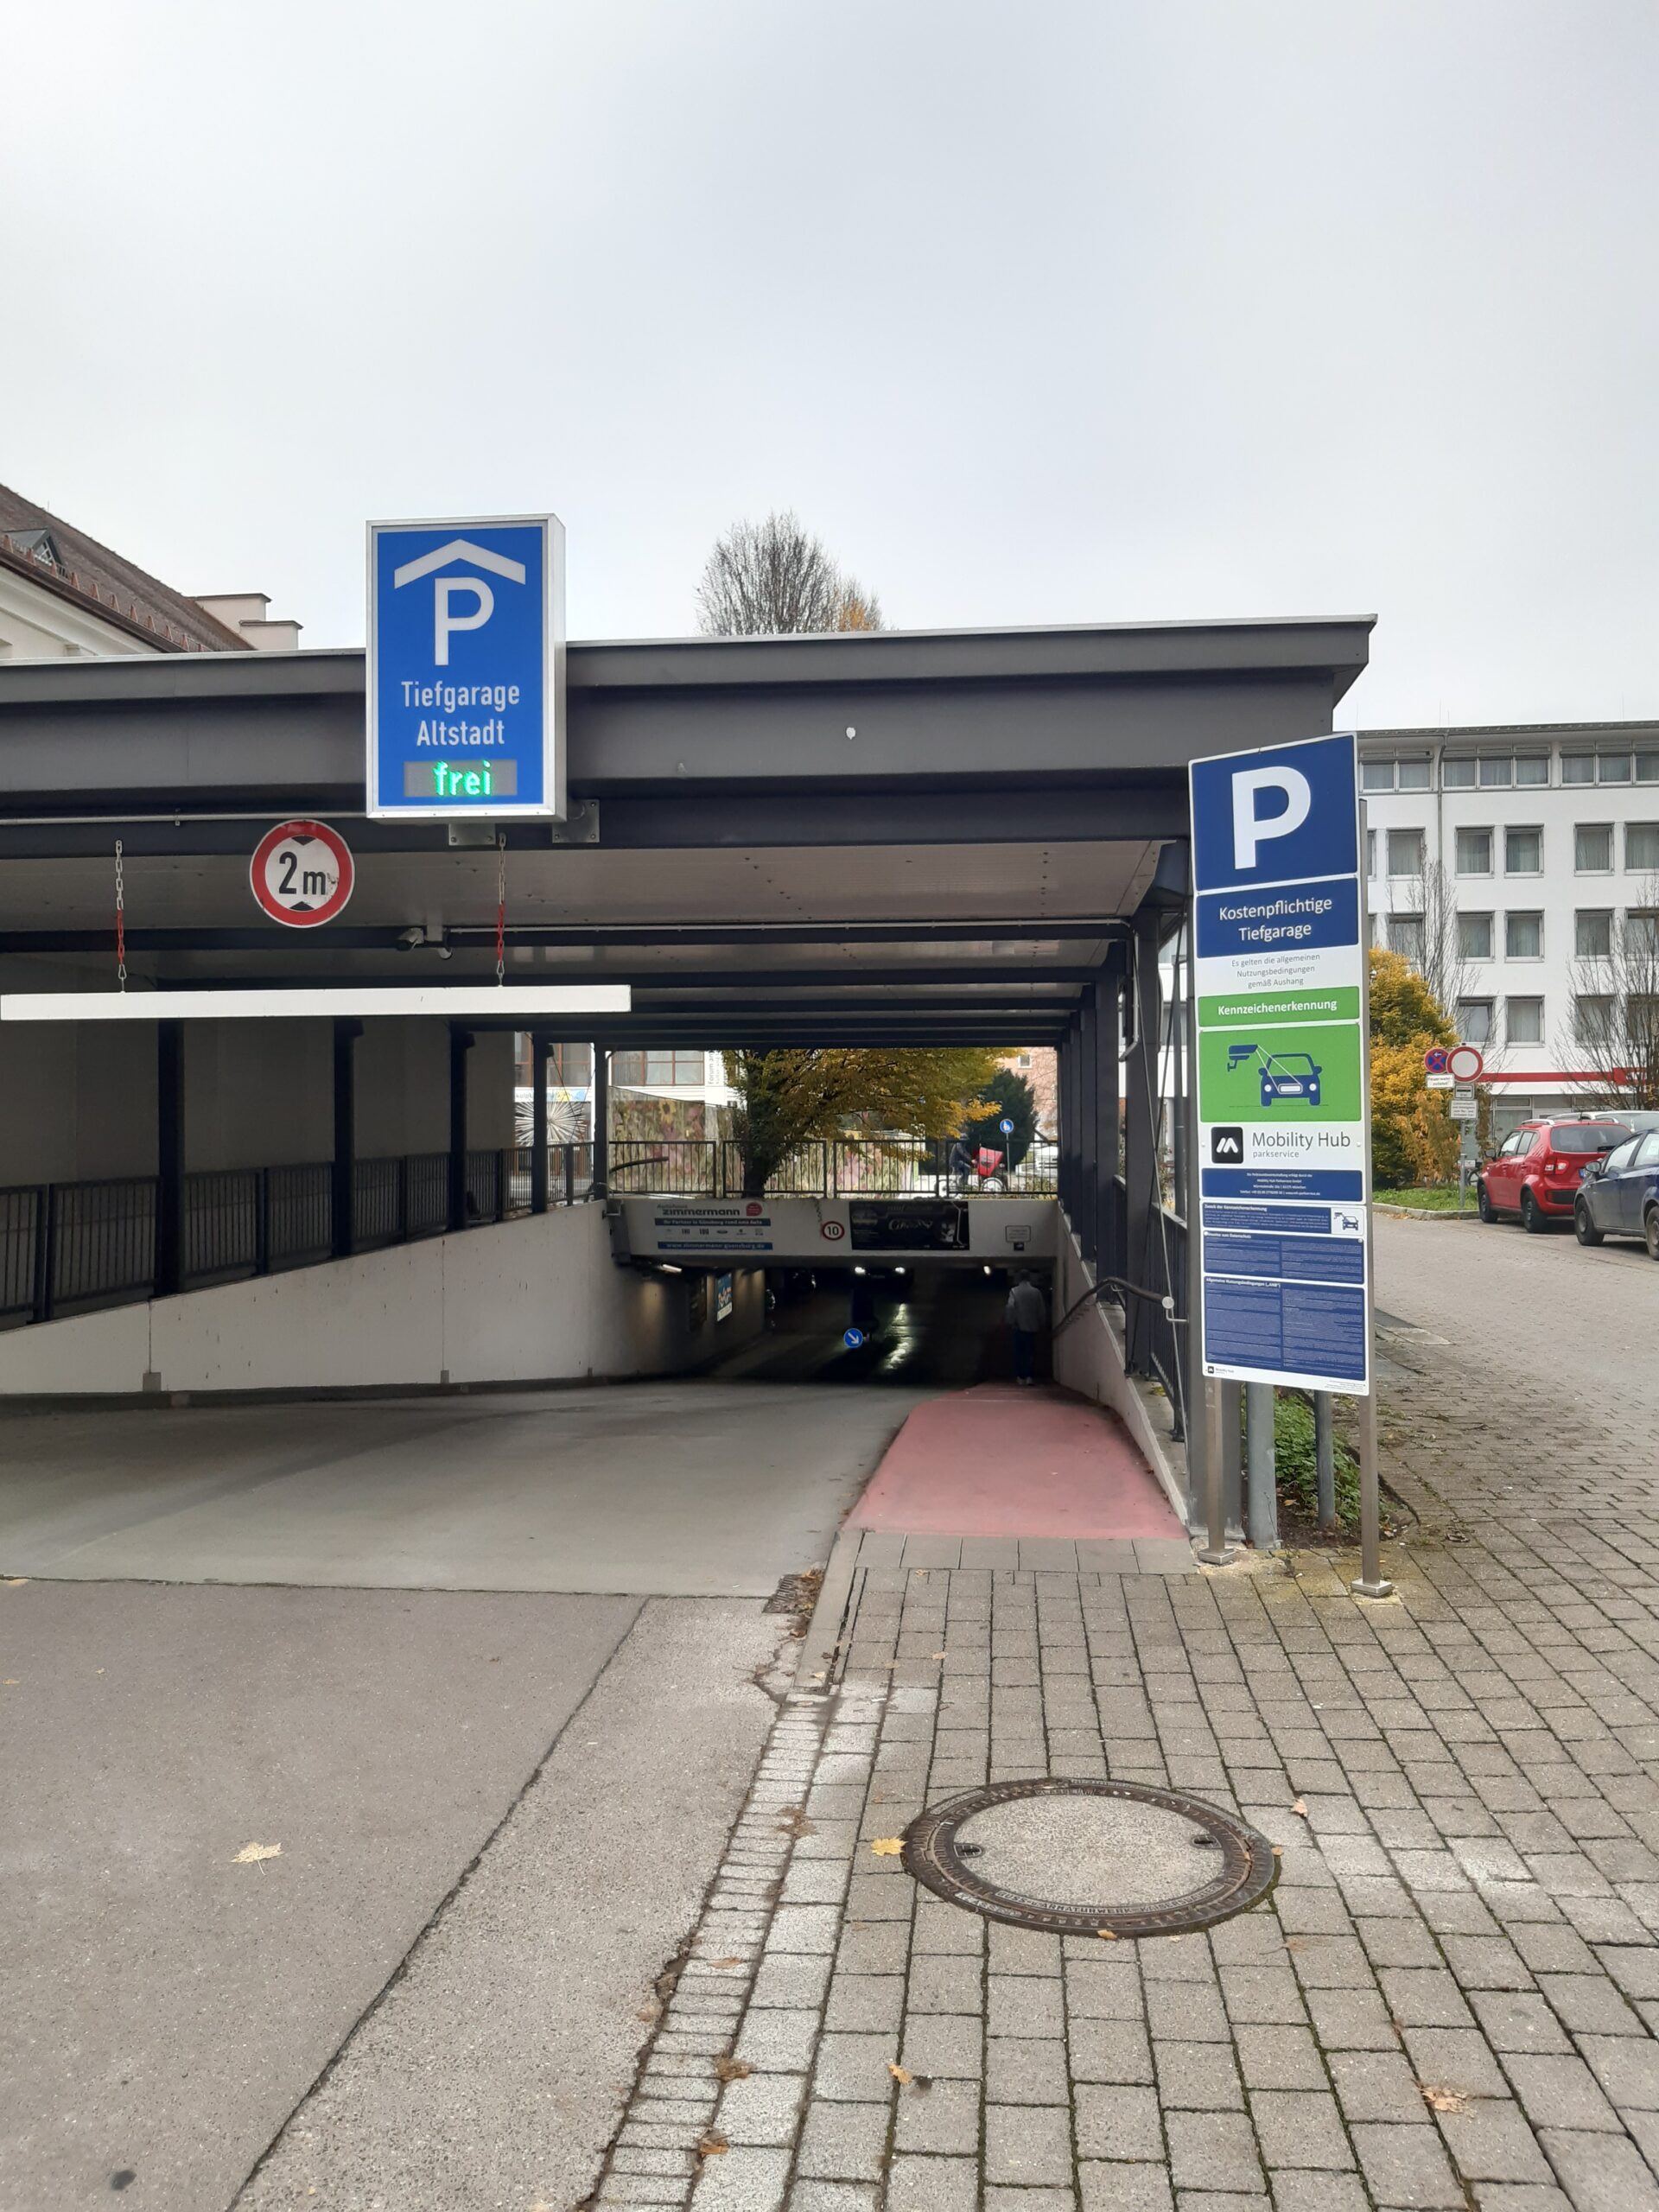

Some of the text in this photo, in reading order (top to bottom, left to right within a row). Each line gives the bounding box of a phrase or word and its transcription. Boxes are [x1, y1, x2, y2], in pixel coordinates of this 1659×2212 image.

[435, 576, 495, 665] P
[401, 680, 520, 714] Tiefgarage
[416, 719, 505, 747] Altstadt
[433, 760, 493, 797] frei
[1231, 766, 1312, 870] P
[1219, 897, 1332, 921] Kostenpflichtige
[1238, 924, 1313, 943] Tiefgarage
[1231, 953, 1320, 968] Es gelten die allgemeinen
[1236, 965, 1315, 978] Nutzungsbedingungen
[1248, 977, 1304, 989] gemäß Aushang
[1217, 1000, 1338, 1016] Kennzeichenerkennung
[1252, 1131, 1351, 1151] Mobility Hub
[1253, 1150, 1300, 1159] parkservice
[827, 1226, 839, 1236] 10
